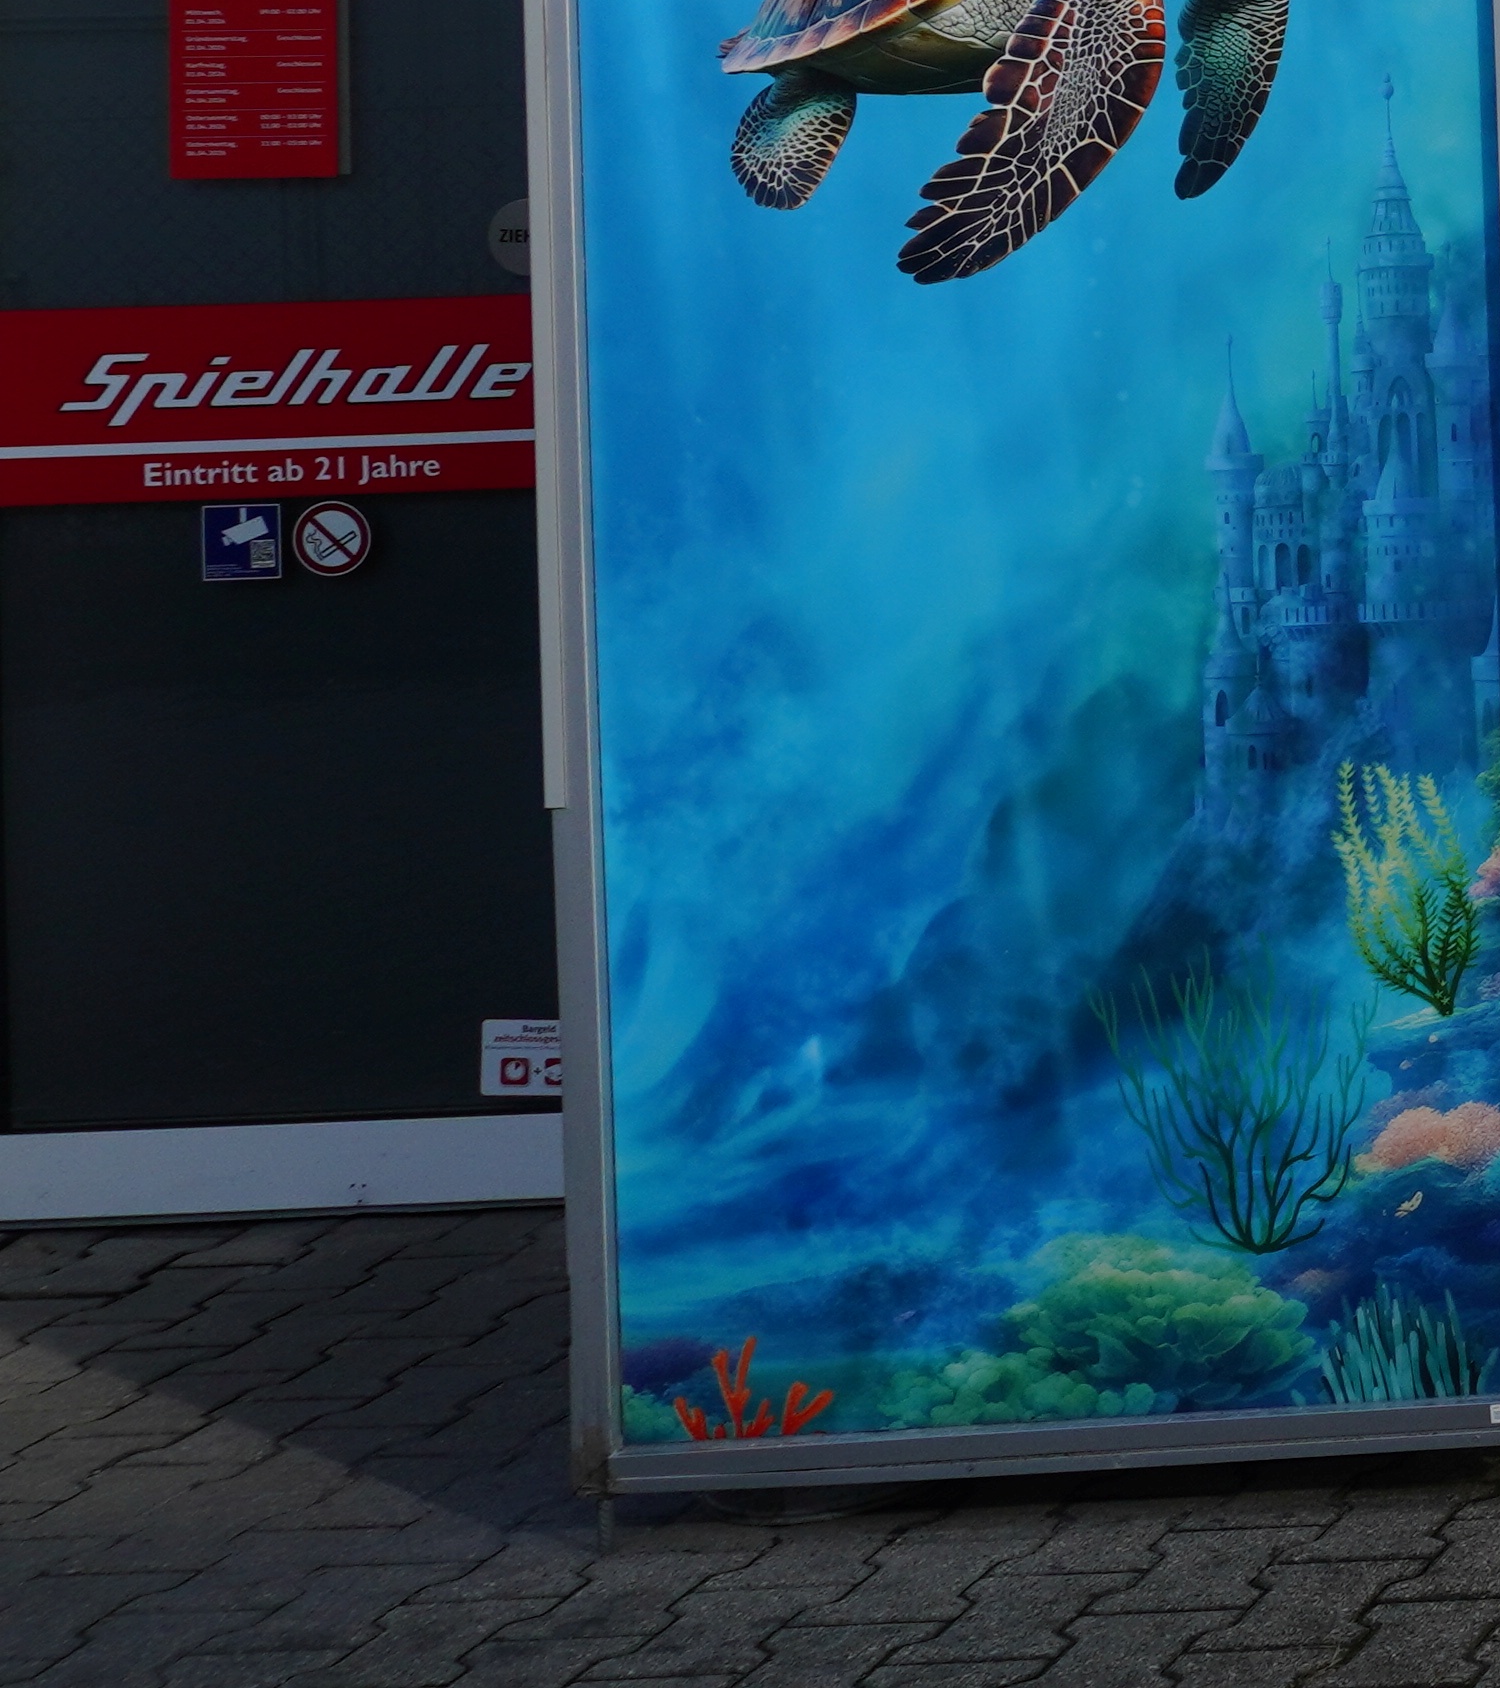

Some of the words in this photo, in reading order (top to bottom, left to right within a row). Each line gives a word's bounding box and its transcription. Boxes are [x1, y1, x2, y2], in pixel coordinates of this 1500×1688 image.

[58, 343, 533, 428] Spielhalle
[143, 458, 258, 488] Eintritt
[267, 458, 304, 483] ab
[314, 456, 346, 481] 21
[358, 453, 442, 486] Jahre
